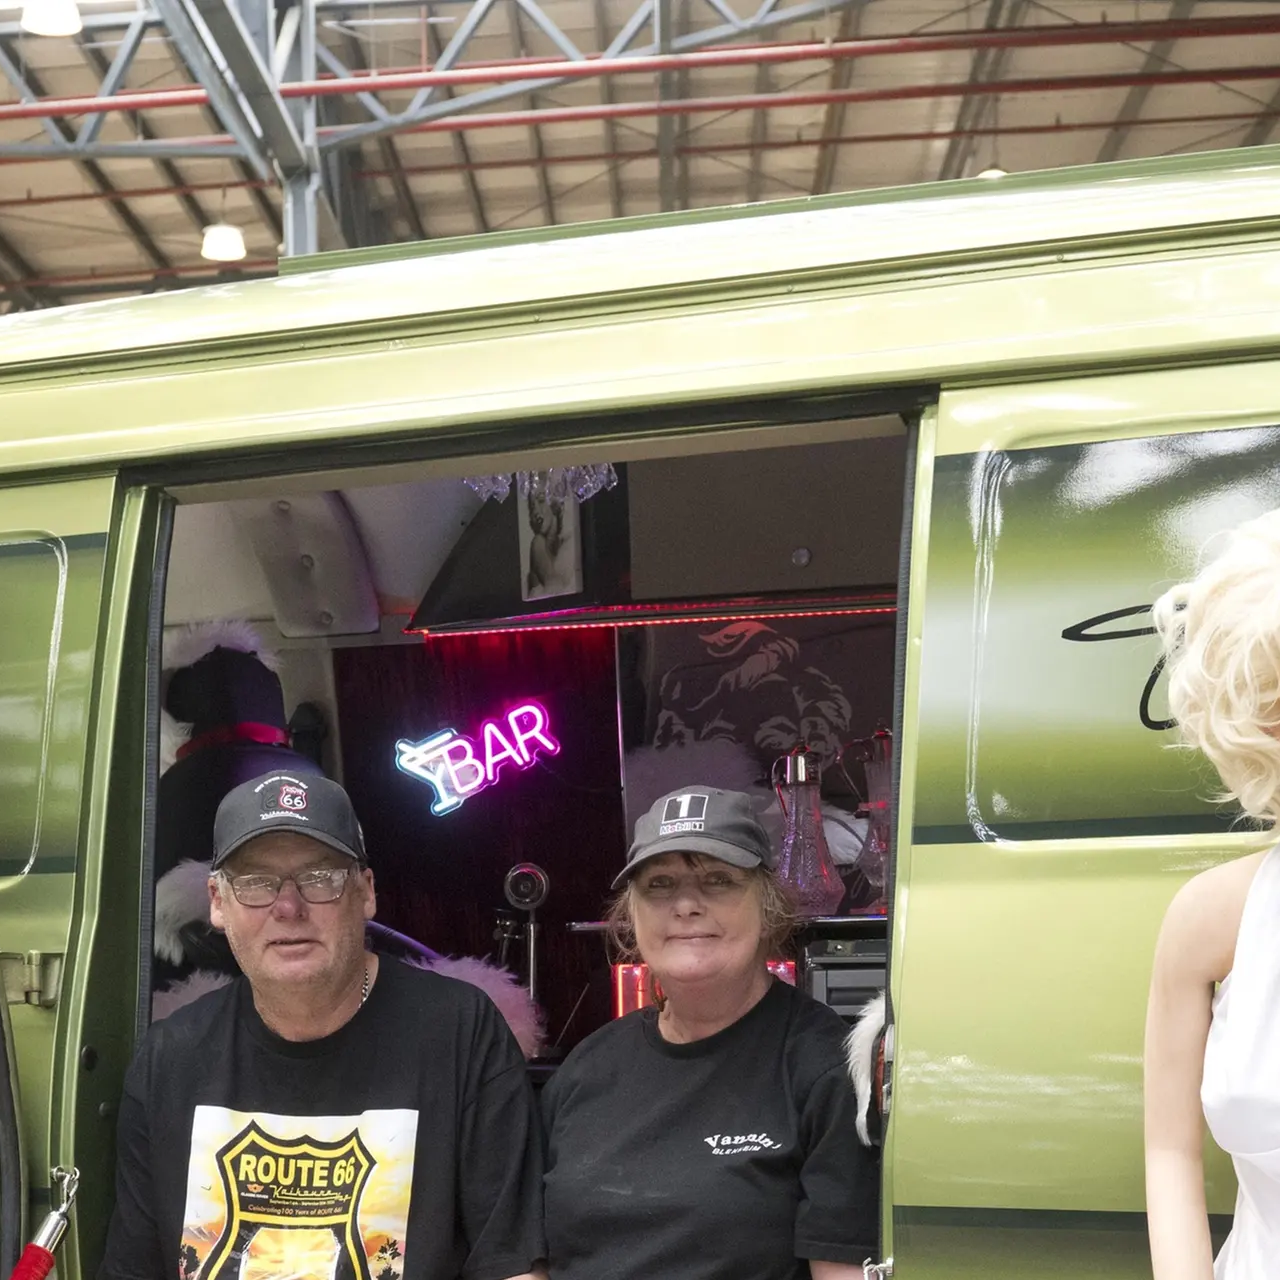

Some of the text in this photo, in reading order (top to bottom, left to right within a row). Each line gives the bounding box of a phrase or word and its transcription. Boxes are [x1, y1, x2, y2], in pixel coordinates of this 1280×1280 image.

[441, 704, 556, 794] BAR
[283, 794, 304, 807] 66
[676, 794, 691, 818] 1
[660, 822, 691, 835] Mobil
[238, 1154, 355, 1187] ROUTE 66
